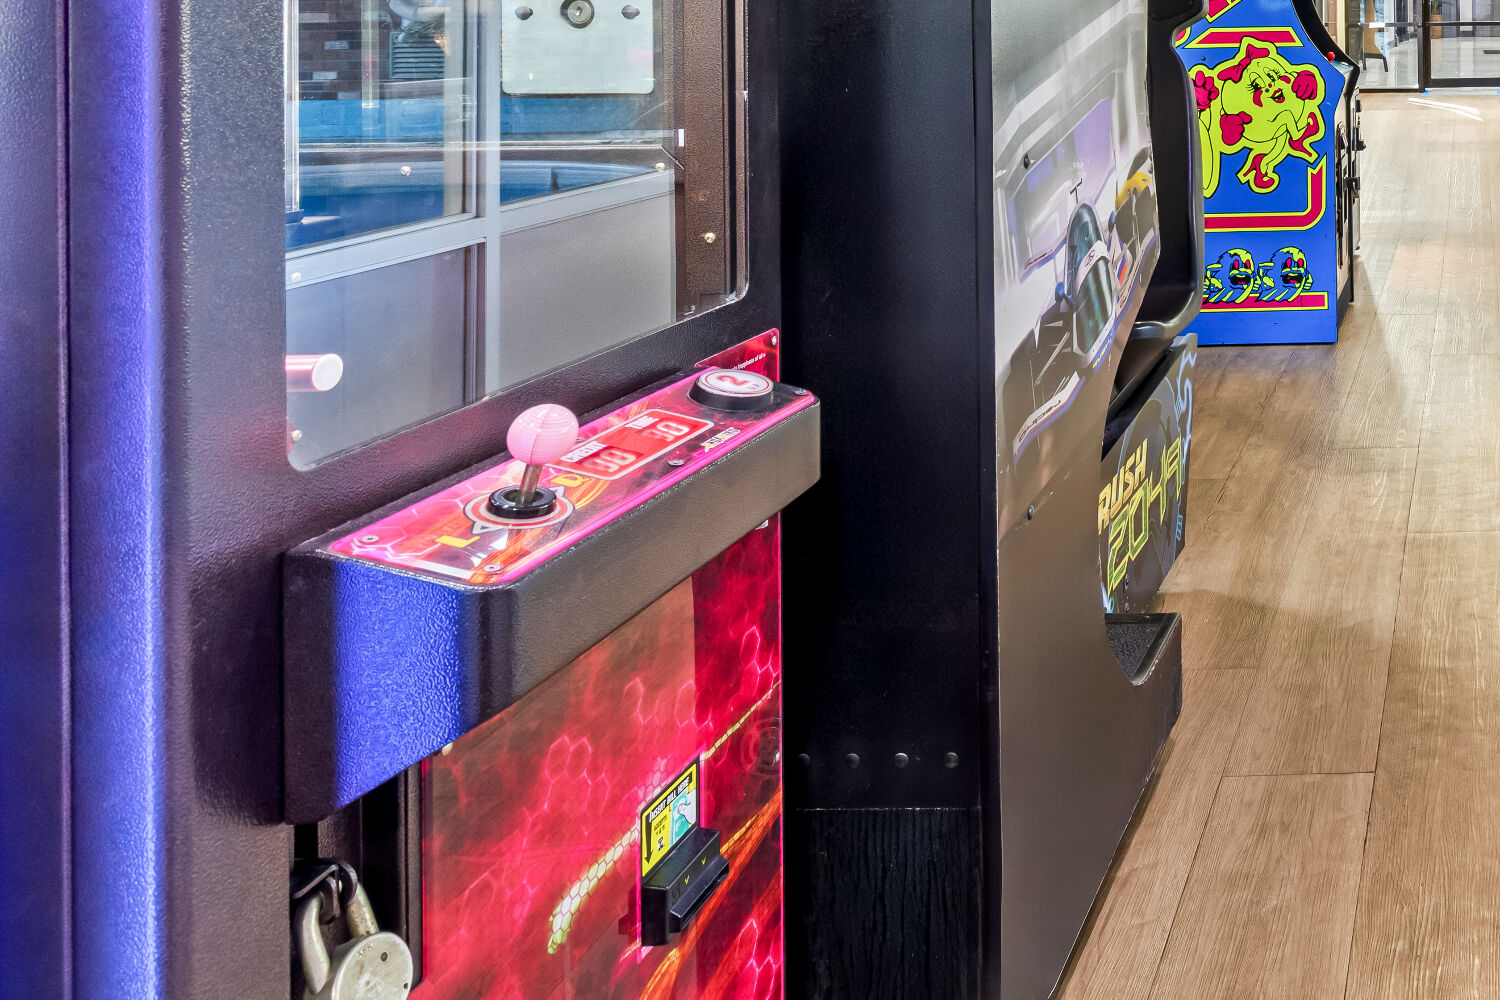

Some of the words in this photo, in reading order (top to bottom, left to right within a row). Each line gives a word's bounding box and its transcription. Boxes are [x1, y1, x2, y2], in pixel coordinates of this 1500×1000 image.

[560, 440, 608, 463] CREDIT
[551, 474, 591, 488] R
[1097, 437, 1148, 536] RUSH
[1107, 435, 1182, 598] 2049
[434, 535, 480, 549] L
[649, 799, 667, 824] INSERT
[666, 790, 677, 806] BILL
[678, 776, 689, 794] HERE
